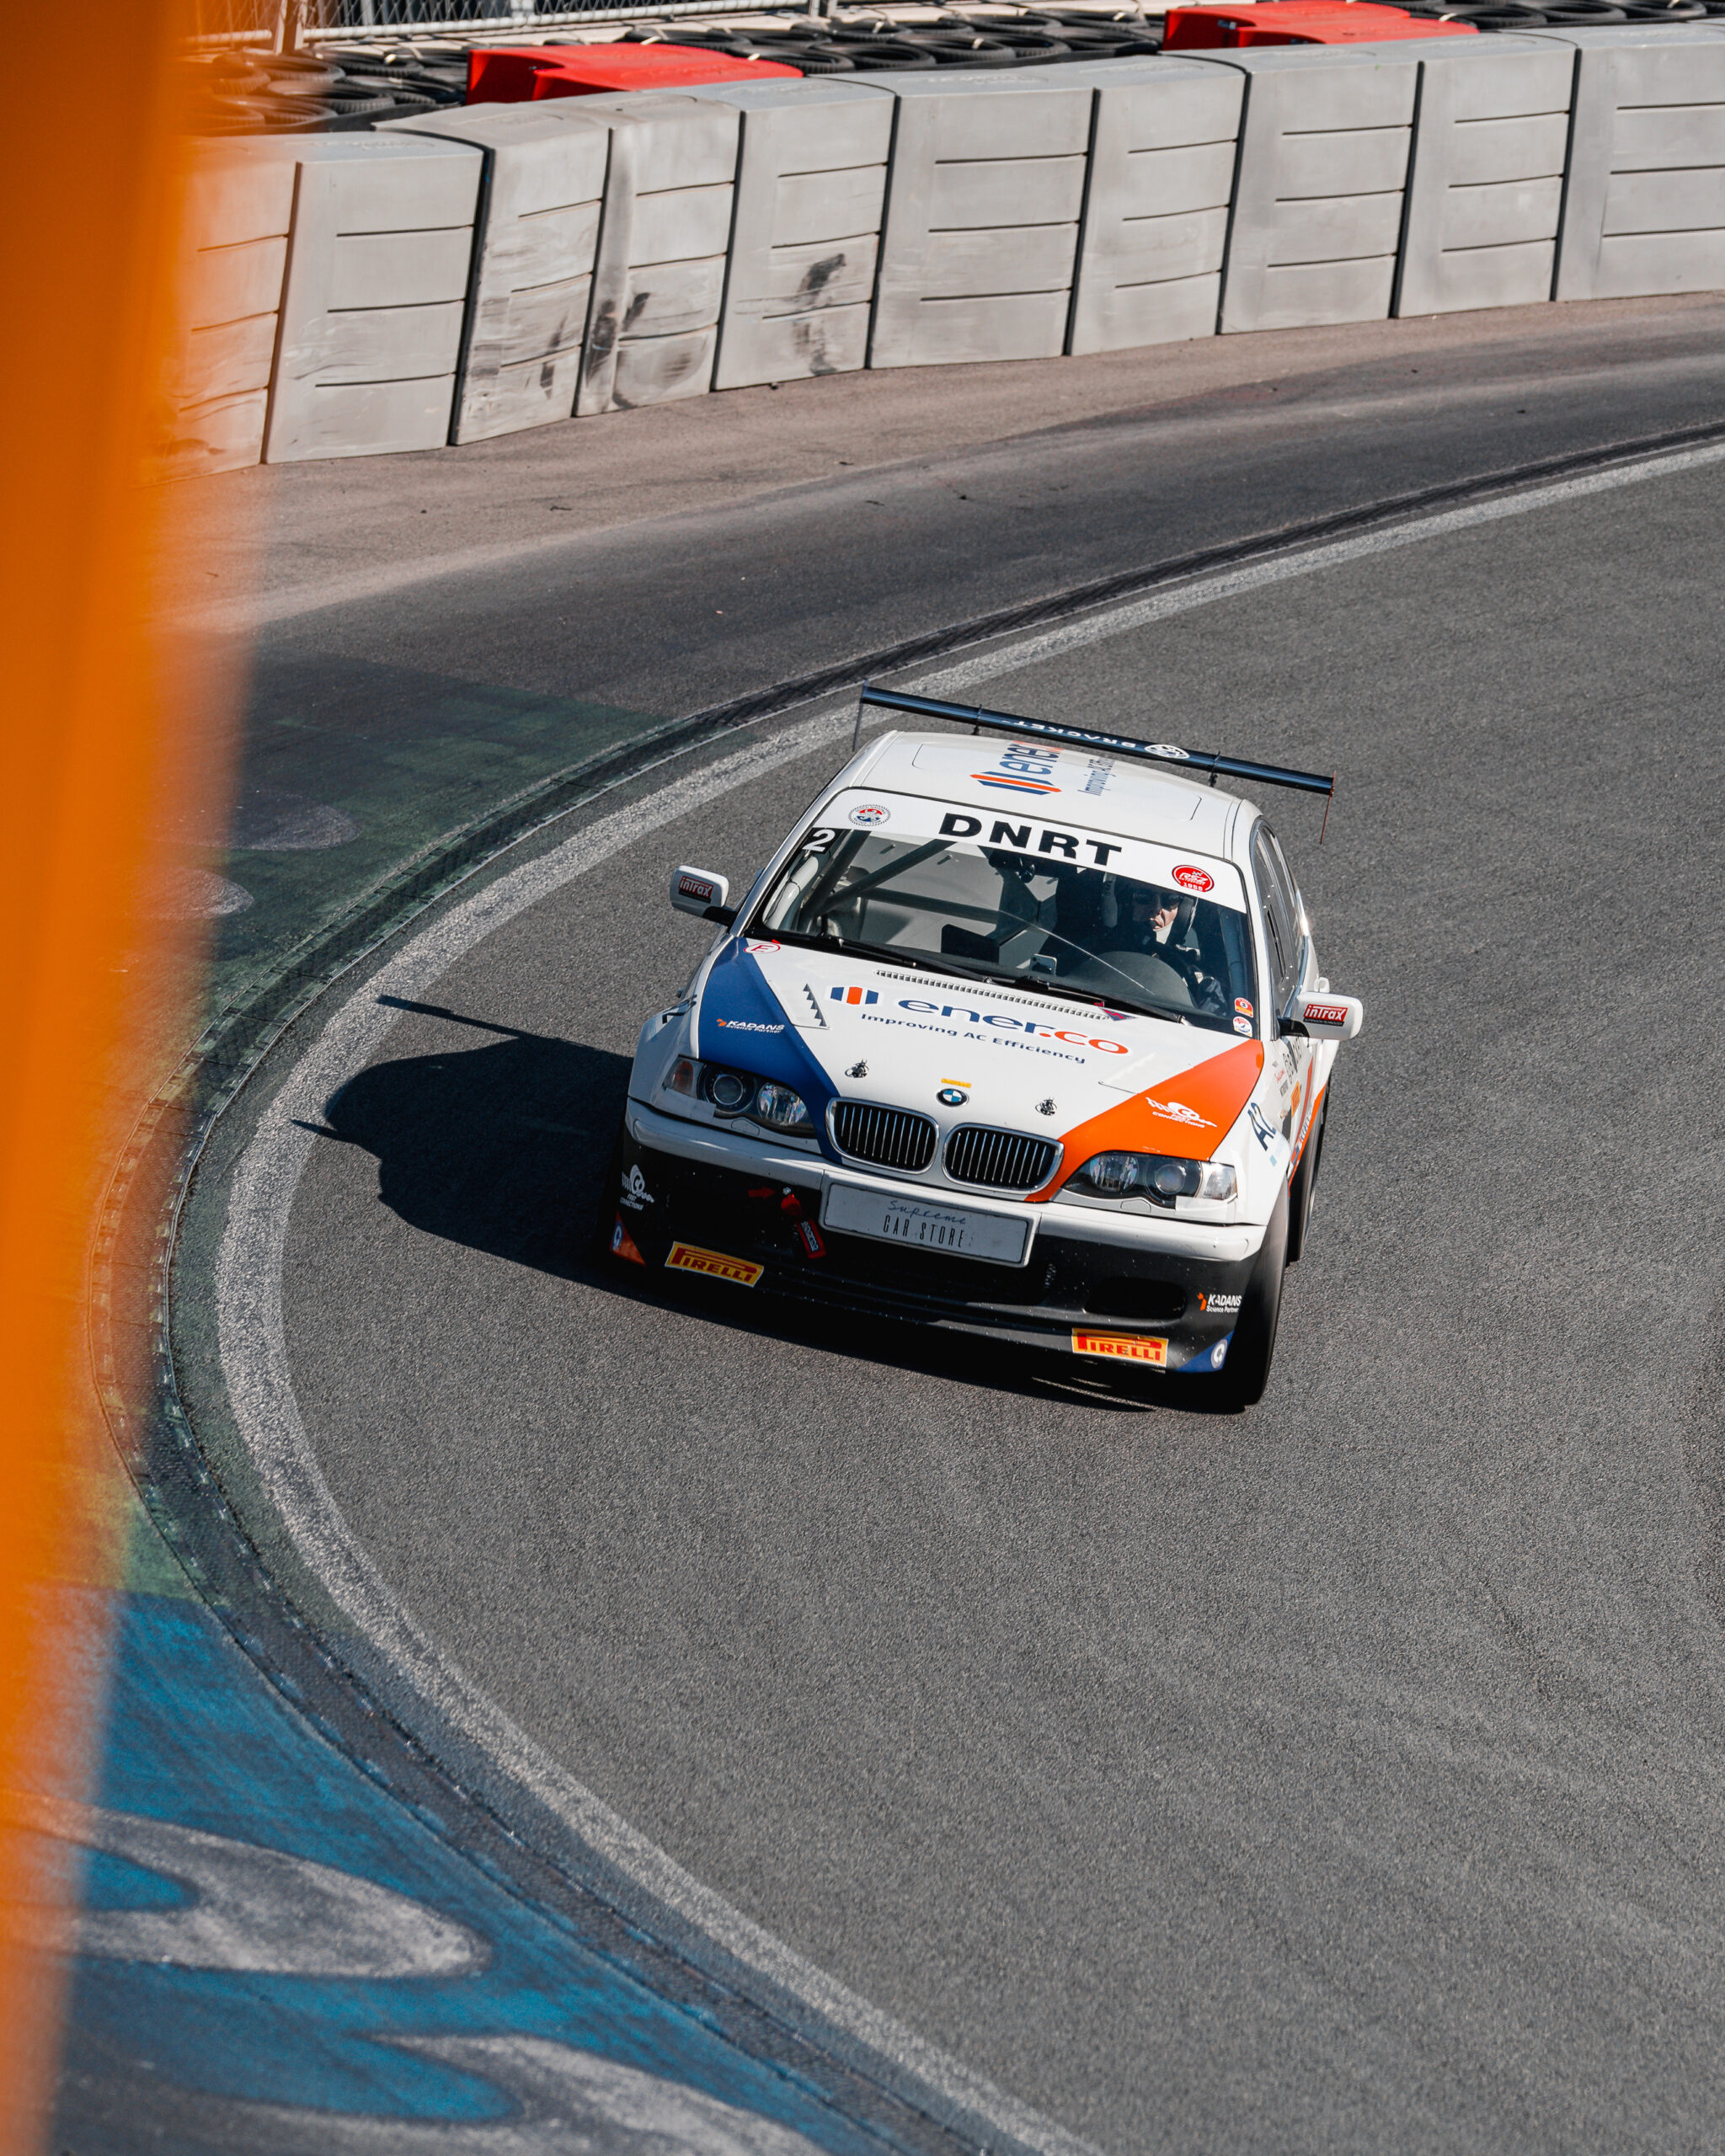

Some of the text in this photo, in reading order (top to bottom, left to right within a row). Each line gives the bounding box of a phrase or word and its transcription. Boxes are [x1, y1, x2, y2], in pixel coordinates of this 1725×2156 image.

[1013, 720, 1137, 750] BRACKET
[802, 829, 836, 852] 2
[938, 813, 1122, 867] DNRT
[727, 1020, 785, 1031] KADANS
[861, 1013, 1086, 1064] Improving AC Efficiency
[898, 999, 1130, 1054] ener.co
[888, 1200, 967, 1225] Supreme
[883, 1215, 964, 1247] CAR STORE
[671, 1246, 757, 1282] PIRELLI
[1208, 1294, 1242, 1306] KADANS
[1076, 1331, 1162, 1361] PIRELLI
